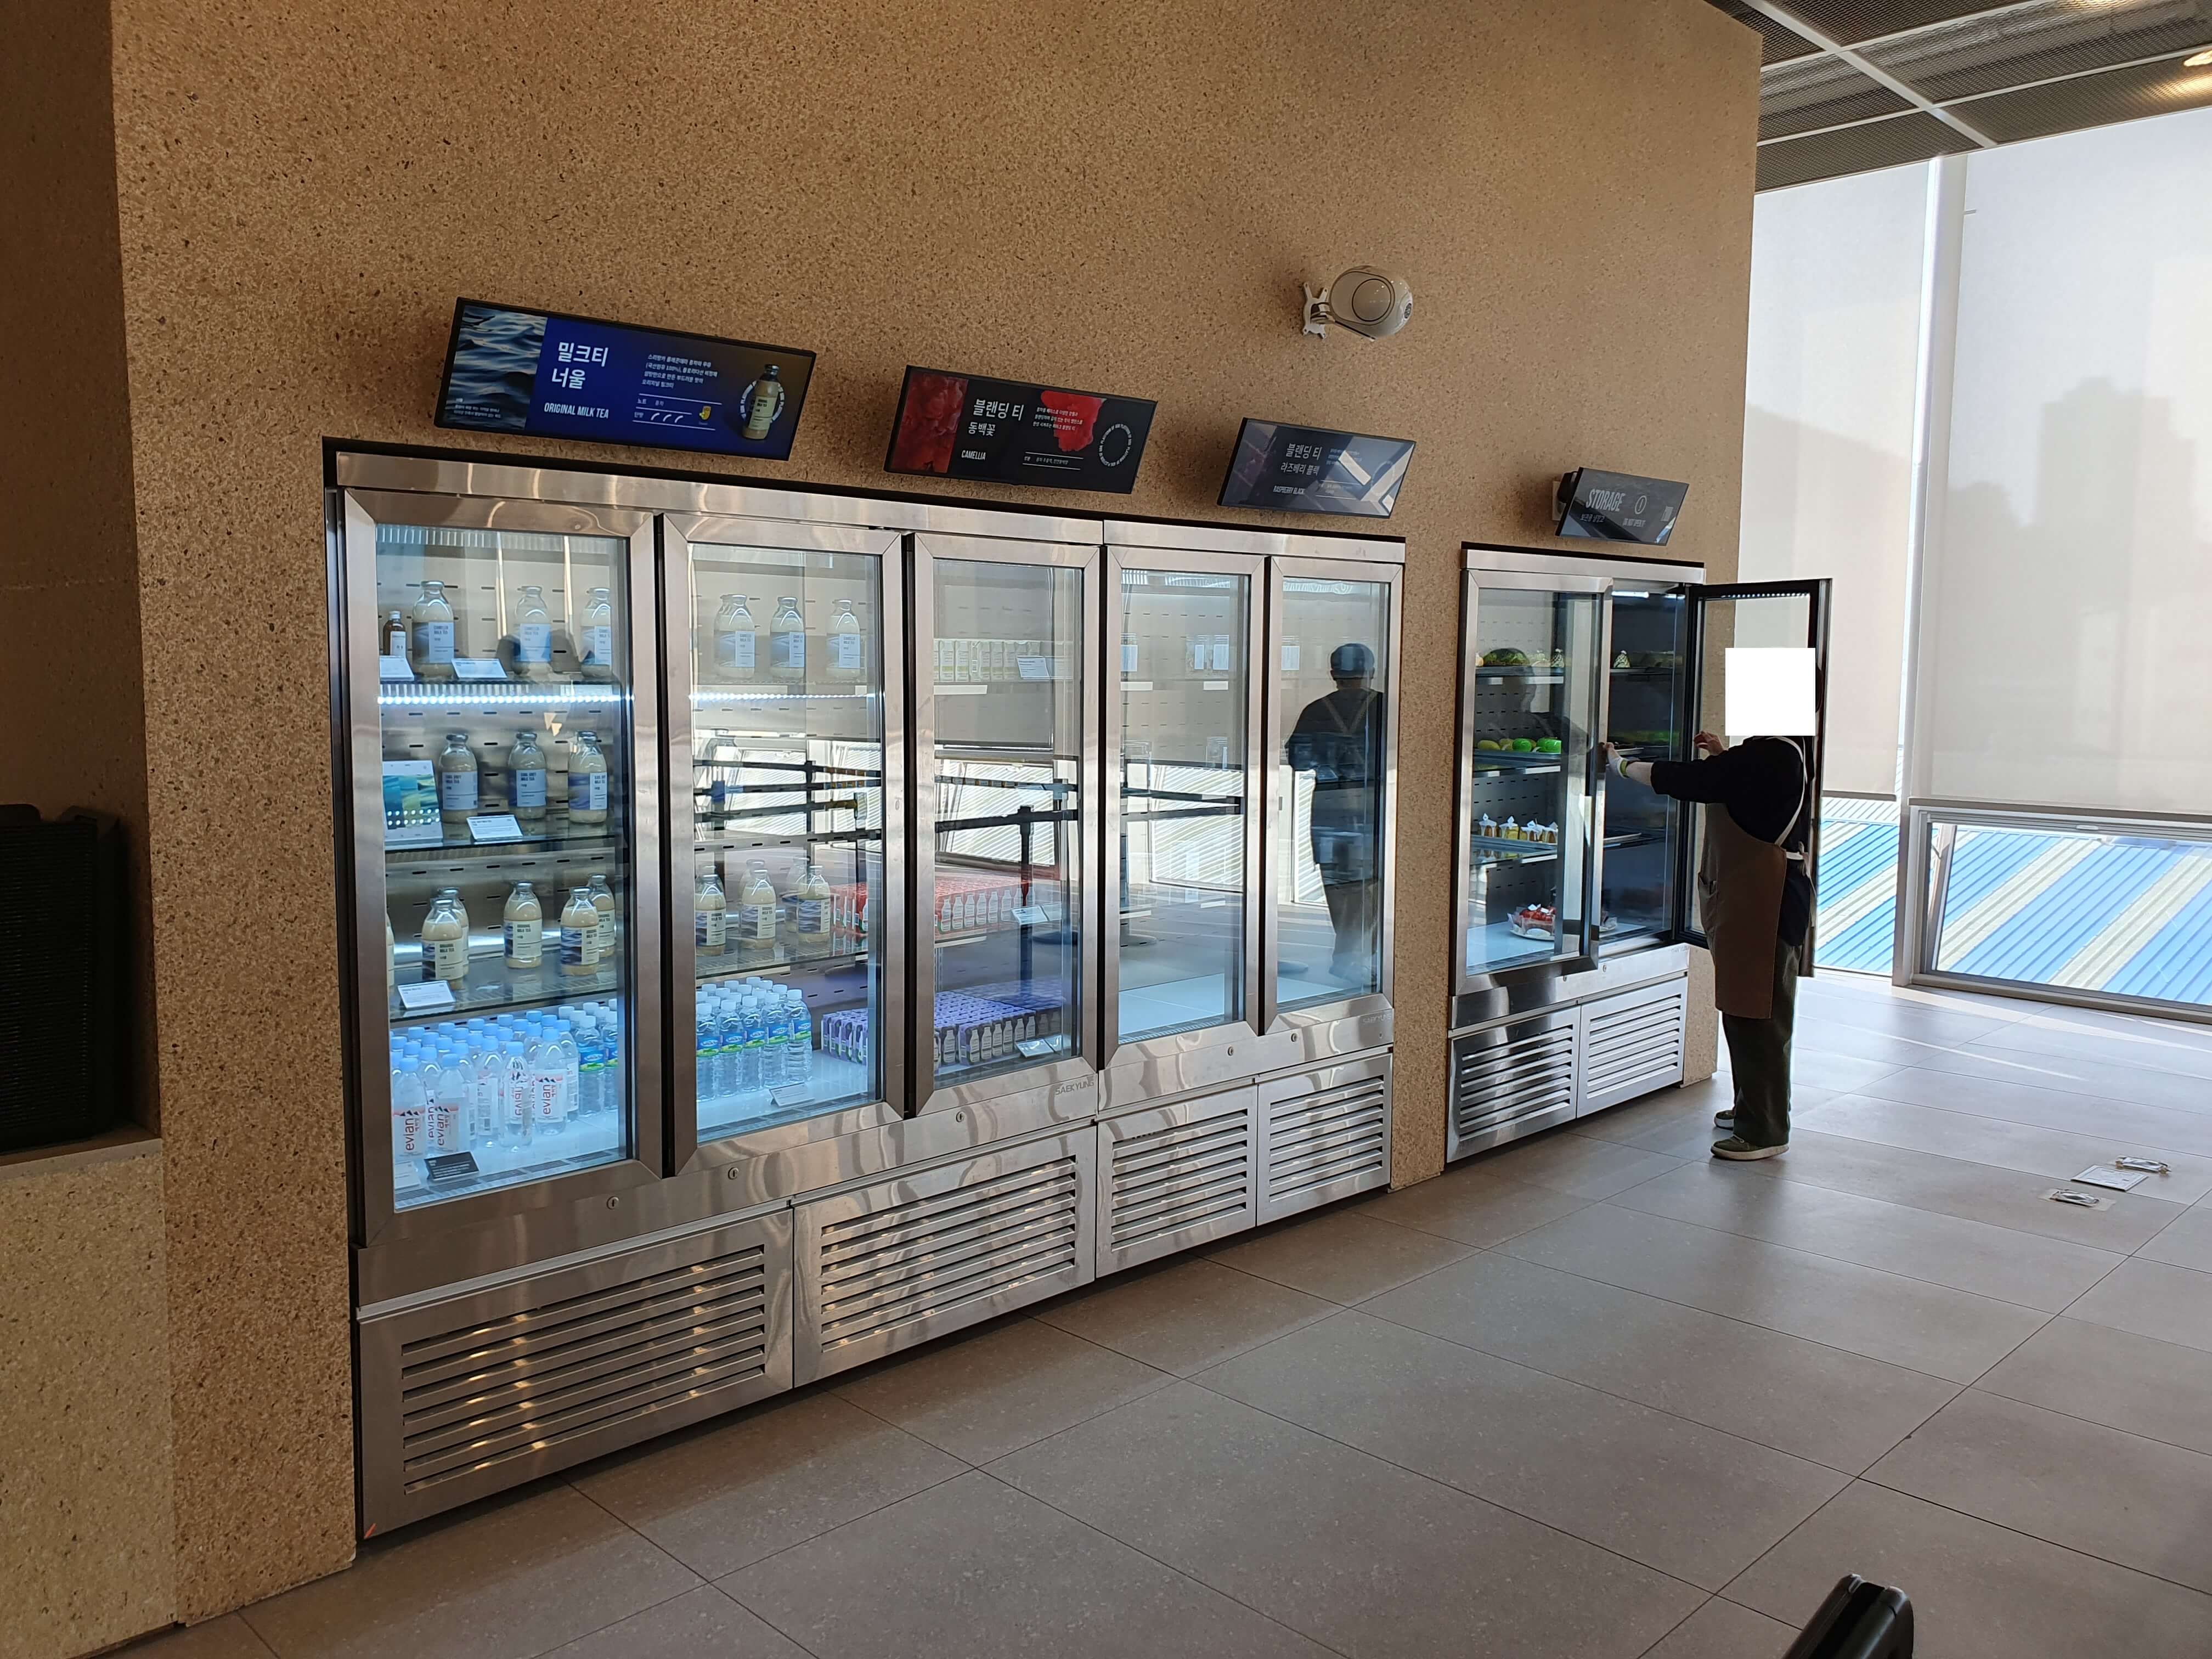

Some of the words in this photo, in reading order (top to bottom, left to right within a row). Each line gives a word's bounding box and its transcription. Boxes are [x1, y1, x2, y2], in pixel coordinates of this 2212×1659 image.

[557, 341, 608, 367] 밀크티
[551, 367, 586, 390] 너울
[544, 402, 576, 416] ORIGINAL
[577, 406, 595, 417] MILK
[596, 408, 610, 419] TEA
[973, 399, 1009, 419] 블랜딩
[1012, 404, 1024, 421] 티
[968, 421, 996, 437] 동백꽃
[961, 450, 986, 460] CAMELLIA
[1312, 446, 1322, 460] 티
[1585, 488, 1626, 512] STORAGE
[1055, 1079, 1094, 1096] SAEKYUNG
[541, 1084, 551, 1115] evian
[404, 1118, 414, 1150] evian
